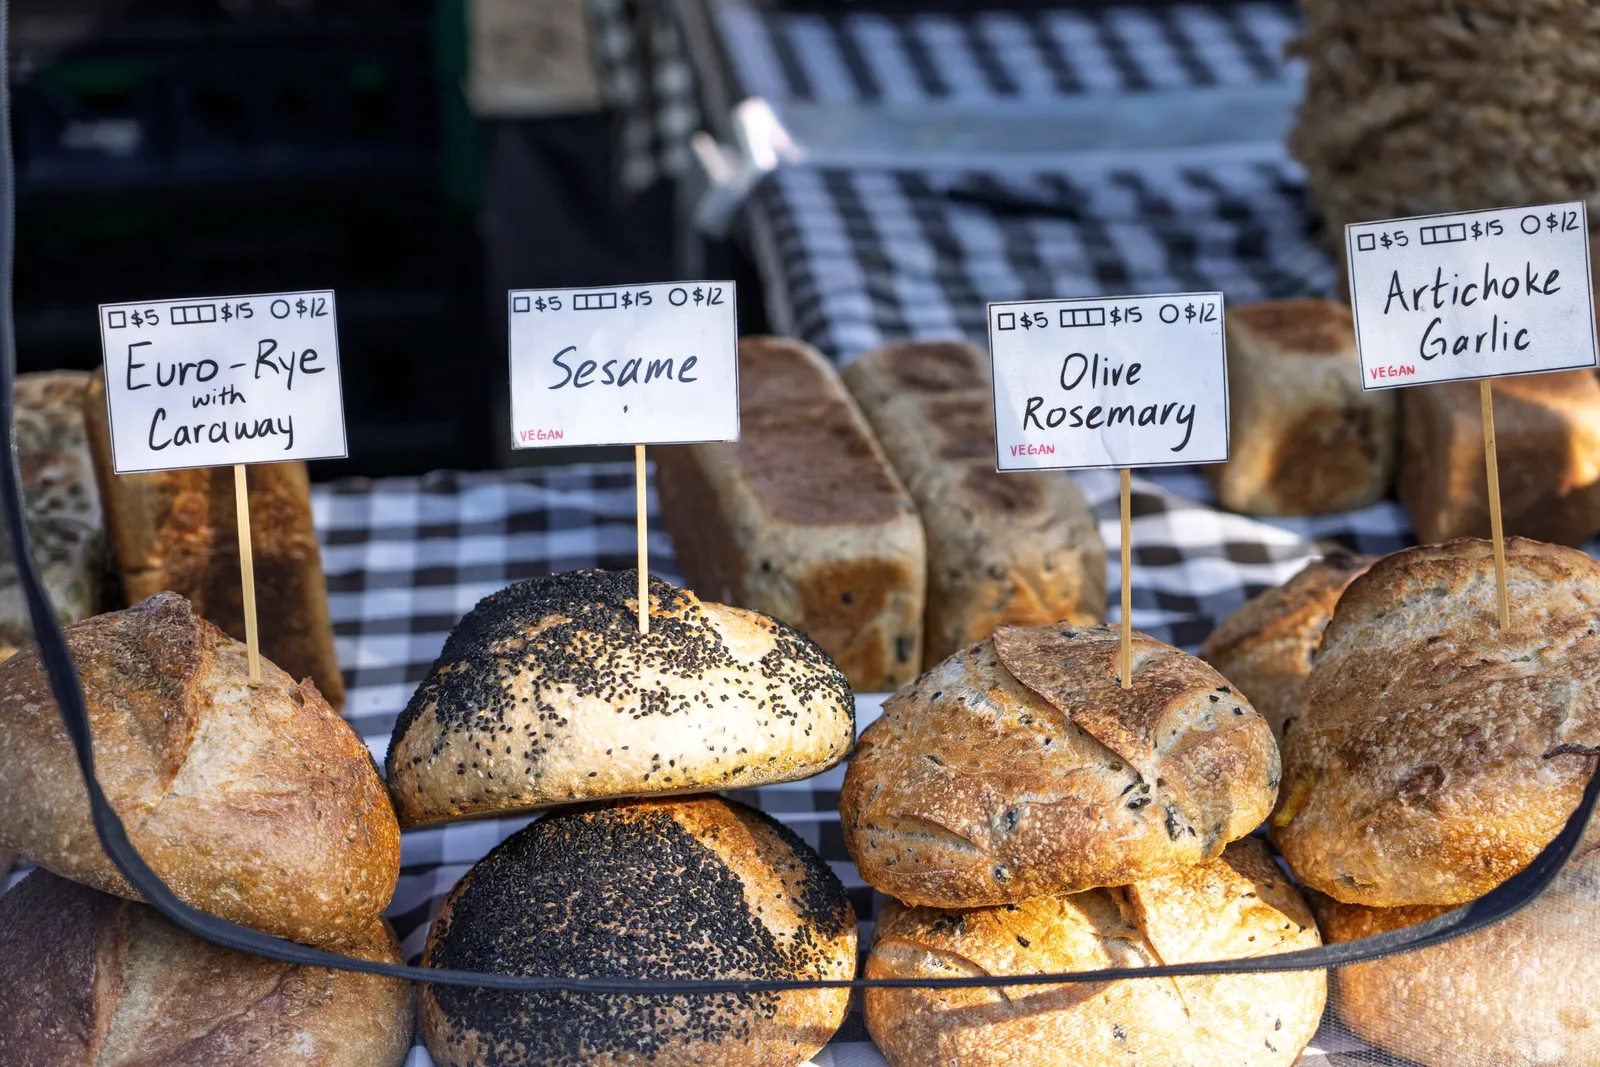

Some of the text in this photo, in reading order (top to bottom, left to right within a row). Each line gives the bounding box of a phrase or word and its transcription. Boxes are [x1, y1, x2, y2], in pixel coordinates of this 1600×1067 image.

[1380, 211, 1579, 249] $5 $15 $12
[535, 287, 724, 312] $5 $15 $12
[1384, 261, 1561, 314] Artichoke
[131, 298, 328, 328] $5 $15 $12
[1020, 303, 1217, 330] $5 $15 $12
[1420, 314, 1530, 360] Garlic
[548, 346, 698, 389] Sesame
[1060, 353, 1142, 390] Olive
[1370, 365, 1415, 379] VEGAN
[193, 384, 246, 408] with
[149, 408, 293, 450] Caraway
[520, 429, 564, 441] VEGAN
[1023, 396, 1195, 452] Rosemary
[1010, 444, 1055, 456] VEGAN
